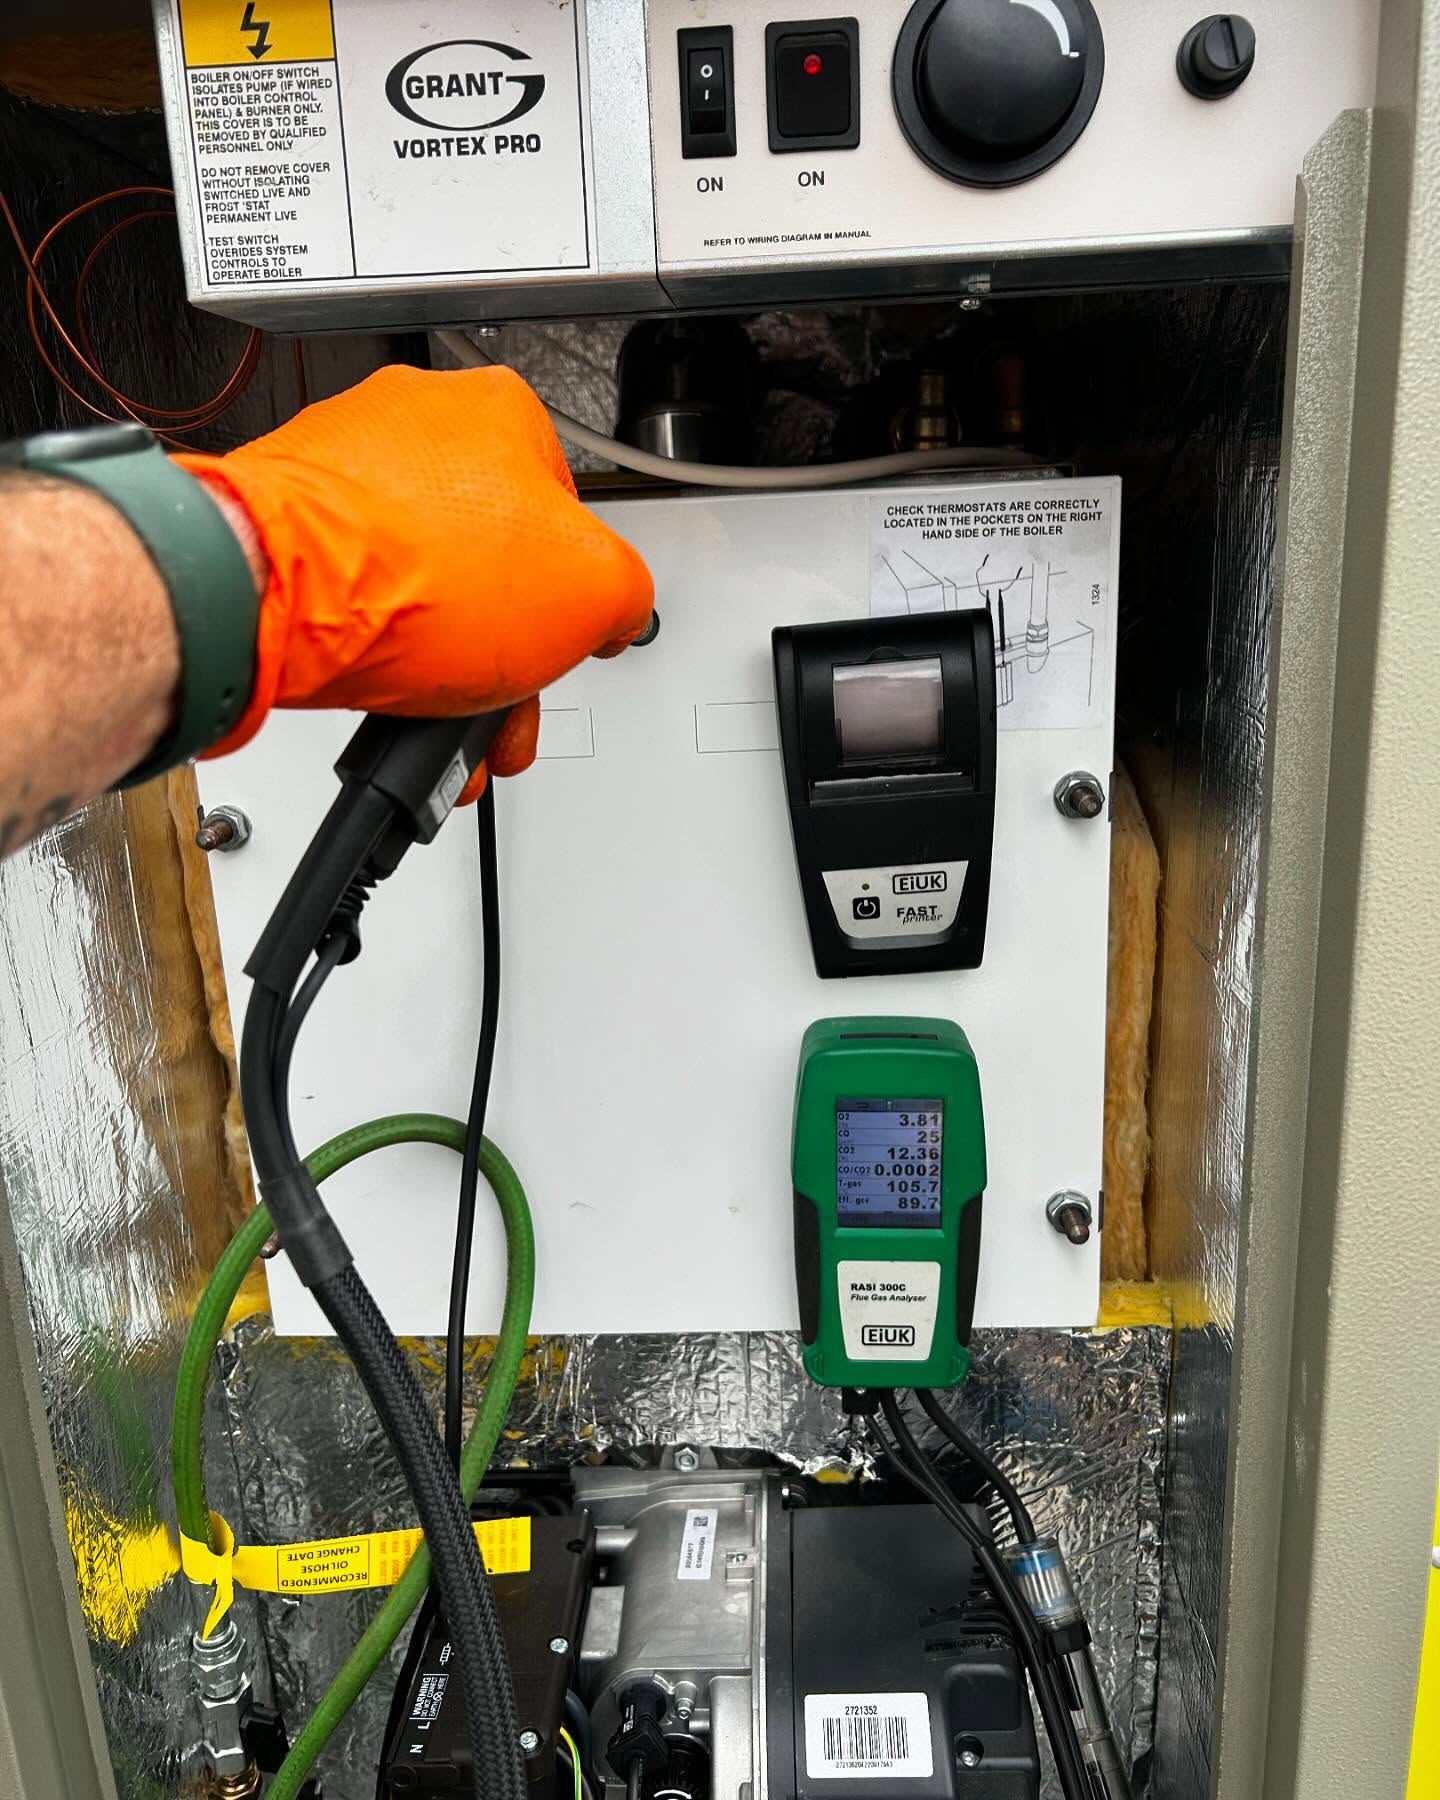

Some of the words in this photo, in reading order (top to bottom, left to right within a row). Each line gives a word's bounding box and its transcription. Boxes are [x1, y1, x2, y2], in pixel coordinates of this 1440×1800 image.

[191, 72, 230, 83] BOILER
[233, 69, 273, 81] ON/OFF
[277, 67, 319, 79] SWITCH
[192, 83, 242, 95] ISOLATES
[246, 81, 276, 92] PUMP
[281, 81, 293, 92] (IF
[296, 79, 332, 89] WIRED
[406, 72, 504, 99] GRANT
[194, 96, 218, 106] INTO
[222, 94, 261, 105] BOILER
[264, 92, 317, 103] CONTROL
[195, 108, 231, 119] PANEL)
[236, 108, 242, 116] &
[247, 106, 290, 116] BURNER
[294, 103, 322, 114] ONLY.
[196, 120, 219, 130] THIS
[223, 119, 259, 129] COVER
[264, 118, 273, 127] IS
[276, 117, 290, 126] TO
[294, 116, 308, 125] BE
[198, 131, 249, 142] REMOVED
[253, 130, 266, 139] BY
[270, 127, 326, 138] QUALIFIED
[199, 142, 263, 154] PERSONNEL
[267, 140, 293, 150] ONLY
[394, 136, 485, 159] VORTEX
[495, 134, 541, 154] PRO
[202, 168, 216, 177] DO
[220, 167, 241, 176] NOT
[245, 164, 290, 175] REMOVE
[293, 163, 330, 173] COVER
[202, 178, 250, 189] WITHOUT
[254, 175, 310, 187] ISOLATING
[697, 177, 723, 192] ON
[798, 171, 824, 186] ON
[204, 189, 259, 200] SWITCHED
[263, 188, 284, 198] LIVE
[288, 187, 310, 196] AND
[206, 202, 239, 212] FROST
[207, 212, 271, 223] PERMANENT
[275, 211, 297, 221] LIVE
[209, 237, 234, 246] TEST
[238, 235, 278, 245] SWITCH
[704, 238, 731, 246] REFER
[735, 237, 745, 245] TO
[748, 235, 779, 244] WIRING
[781, 233, 821, 242] DIAGRAM
[835, 231, 871, 239] MANUAL
[211, 247, 262, 258] OVERIDES
[266, 245, 308, 256] SYSTEM
[212, 258, 269, 269] CONTROLS
[272, 257, 286, 267] TO
[213, 270, 260, 280] OPERATE
[264, 268, 302, 278] BOILER
[887, 506, 924, 516] CHECK
[927, 503, 1006, 513] THERMOSTATS
[1009, 502, 1030, 511] ARE
[1034, 499, 1100, 510] CORRECTLY
[884, 518, 933, 528] LOCATED
[936, 517, 947, 526] IN
[950, 516, 970, 526] THE
[974, 514, 1024, 525] POCKETS
[1027, 514, 1041, 523] ON
[1045, 513, 1066, 522] THE
[1069, 512, 1102, 522] RIGHT
[922, 530, 951, 540] HAND
[955, 528, 979, 538] SIDE
[982, 528, 997, 537] OF
[1000, 527, 1020, 536] THE
[1024, 526, 1062, 536] BOILER
[1092, 583, 1100, 605] 1324
[900, 875, 941, 890] EiUK
[897, 905, 937, 917] FAST
[903, 914, 943, 925] printer
[899, 1114, 938, 1126] 3.81
[918, 1131, 939, 1143] 25
[888, 1148, 938, 1160] 12.36
[875, 1164, 938, 1176] 0.0002
[888, 1181, 938, 1193] 105.7
[898, 1197, 938, 1209] 89.7
[851, 1283, 876, 1291] RASI
[890, 1294, 926, 1302] Analyser
[869, 1329, 909, 1342] EiUK
[288, 1552, 313, 1561] DATE
[317, 1546, 360, 1558] CHANGE
[302, 1564, 329, 1573] HOSE
[332, 1561, 348, 1569] OIL
[282, 1572, 367, 1586] RECOMMENDED
[412, 1677, 431, 1715] WARNING
[845, 1706, 878, 1715] 2721352
